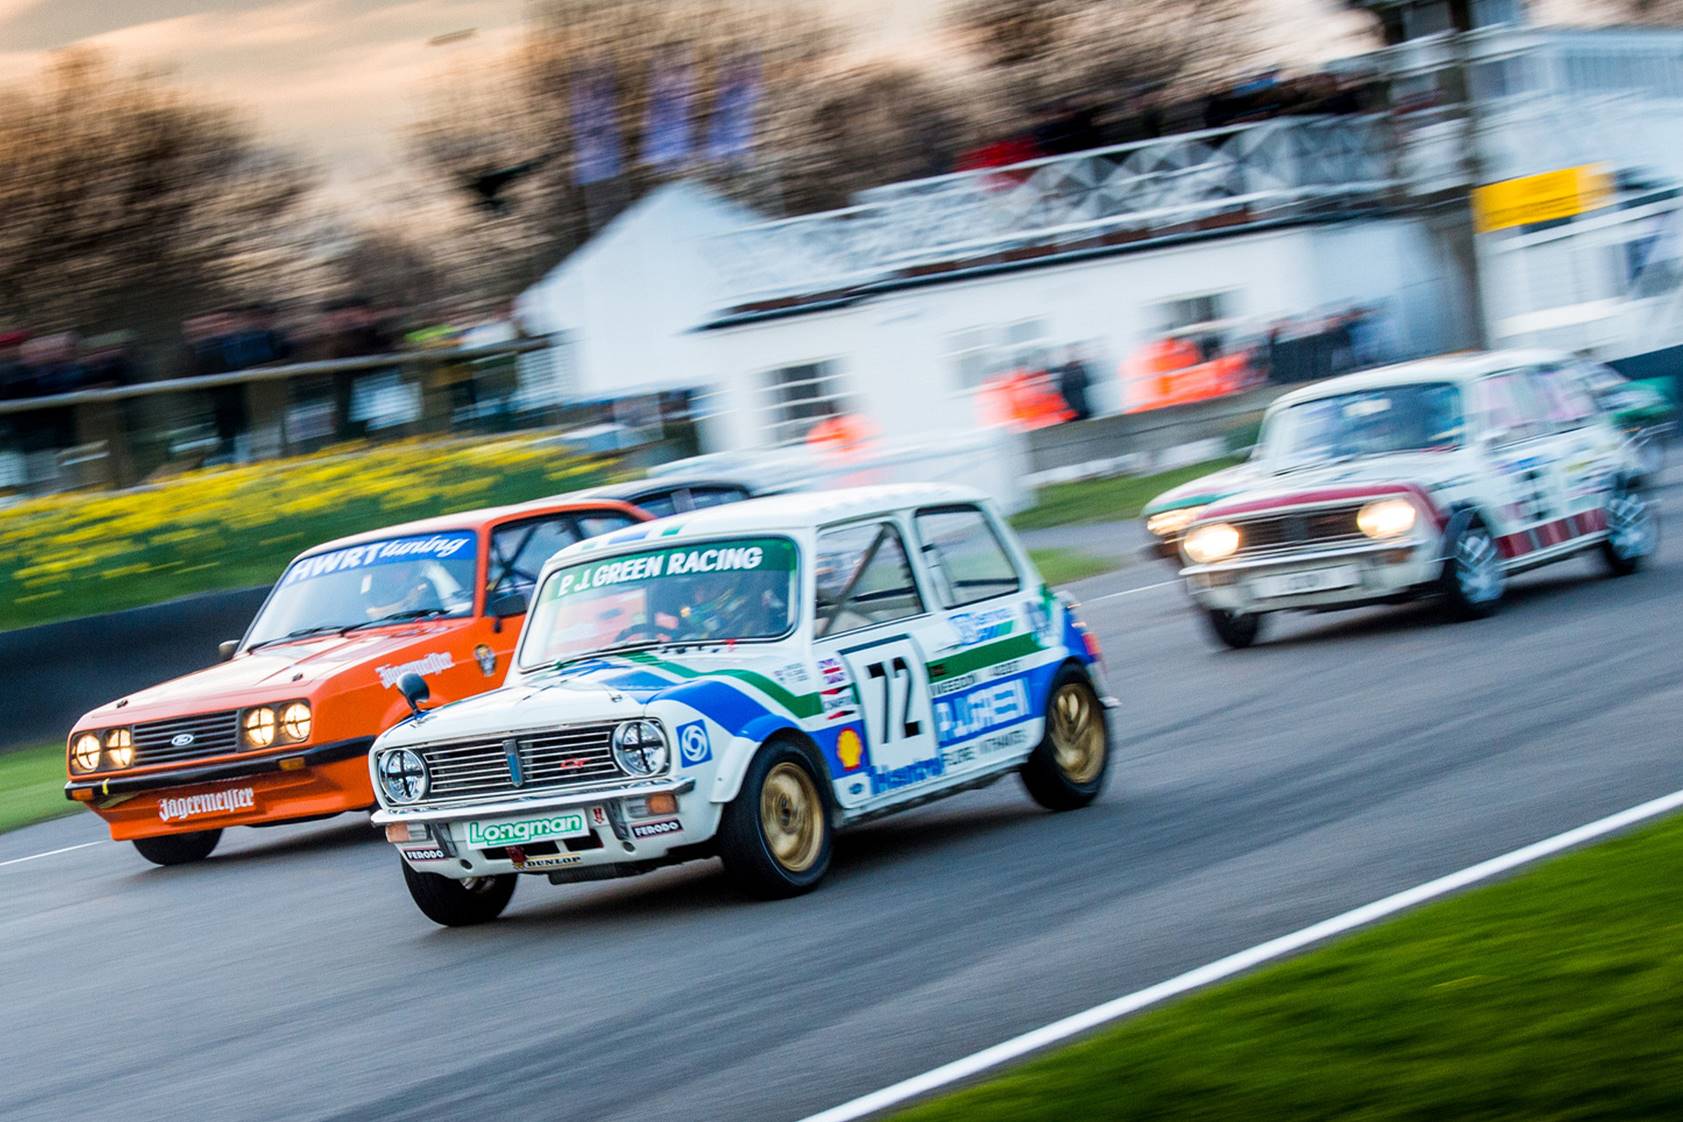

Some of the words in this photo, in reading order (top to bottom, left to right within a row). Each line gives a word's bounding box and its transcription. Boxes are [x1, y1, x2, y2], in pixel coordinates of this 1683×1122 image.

[379, 536, 470, 558] tuning
[666, 547, 763, 576] RACING
[866, 656, 922, 744] 72
[469, 815, 582, 847] Longman
[635, 822, 679, 838] FERODO
[406, 850, 444, 860] FERODO
[526, 856, 582, 867] DUNLOP
